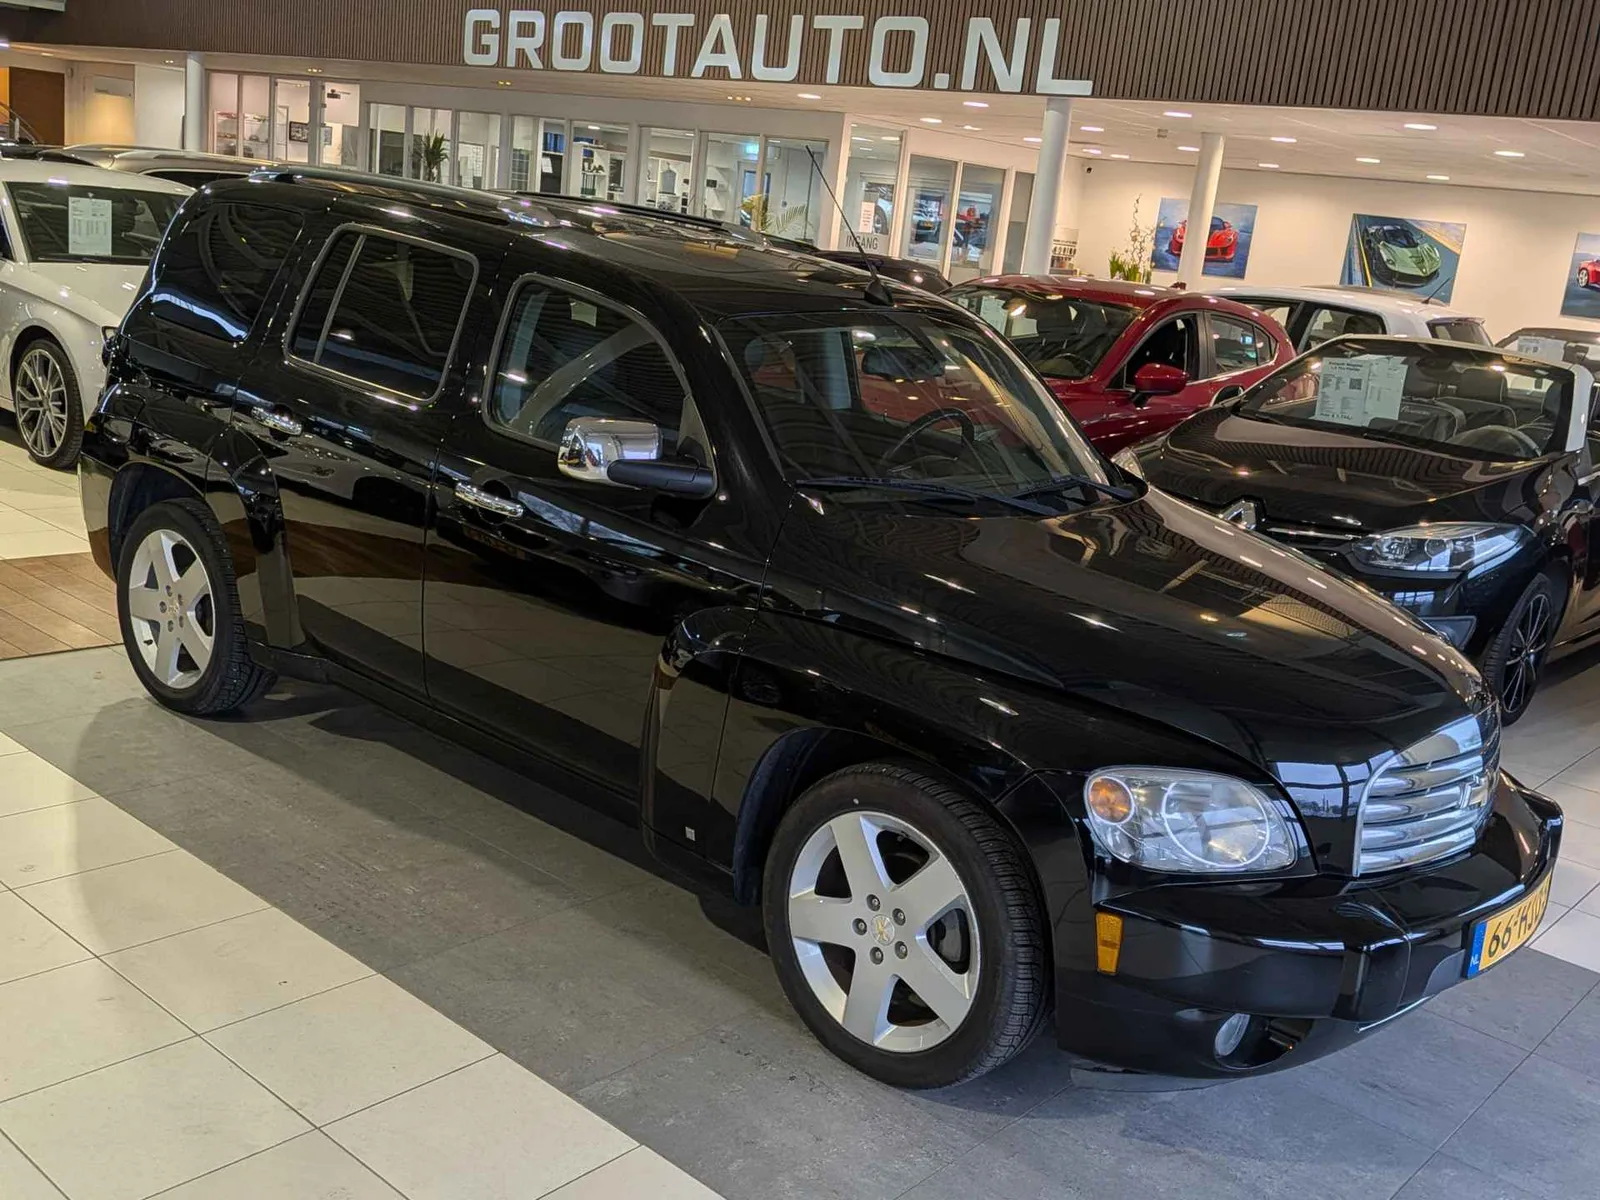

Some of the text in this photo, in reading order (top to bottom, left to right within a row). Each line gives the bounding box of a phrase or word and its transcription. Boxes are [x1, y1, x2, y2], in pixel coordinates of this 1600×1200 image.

[463, 8, 1093, 96] GROOTAUTO.NL
[845, 234, 878, 251] INGANG
[1470, 954, 1480, 967] NL
